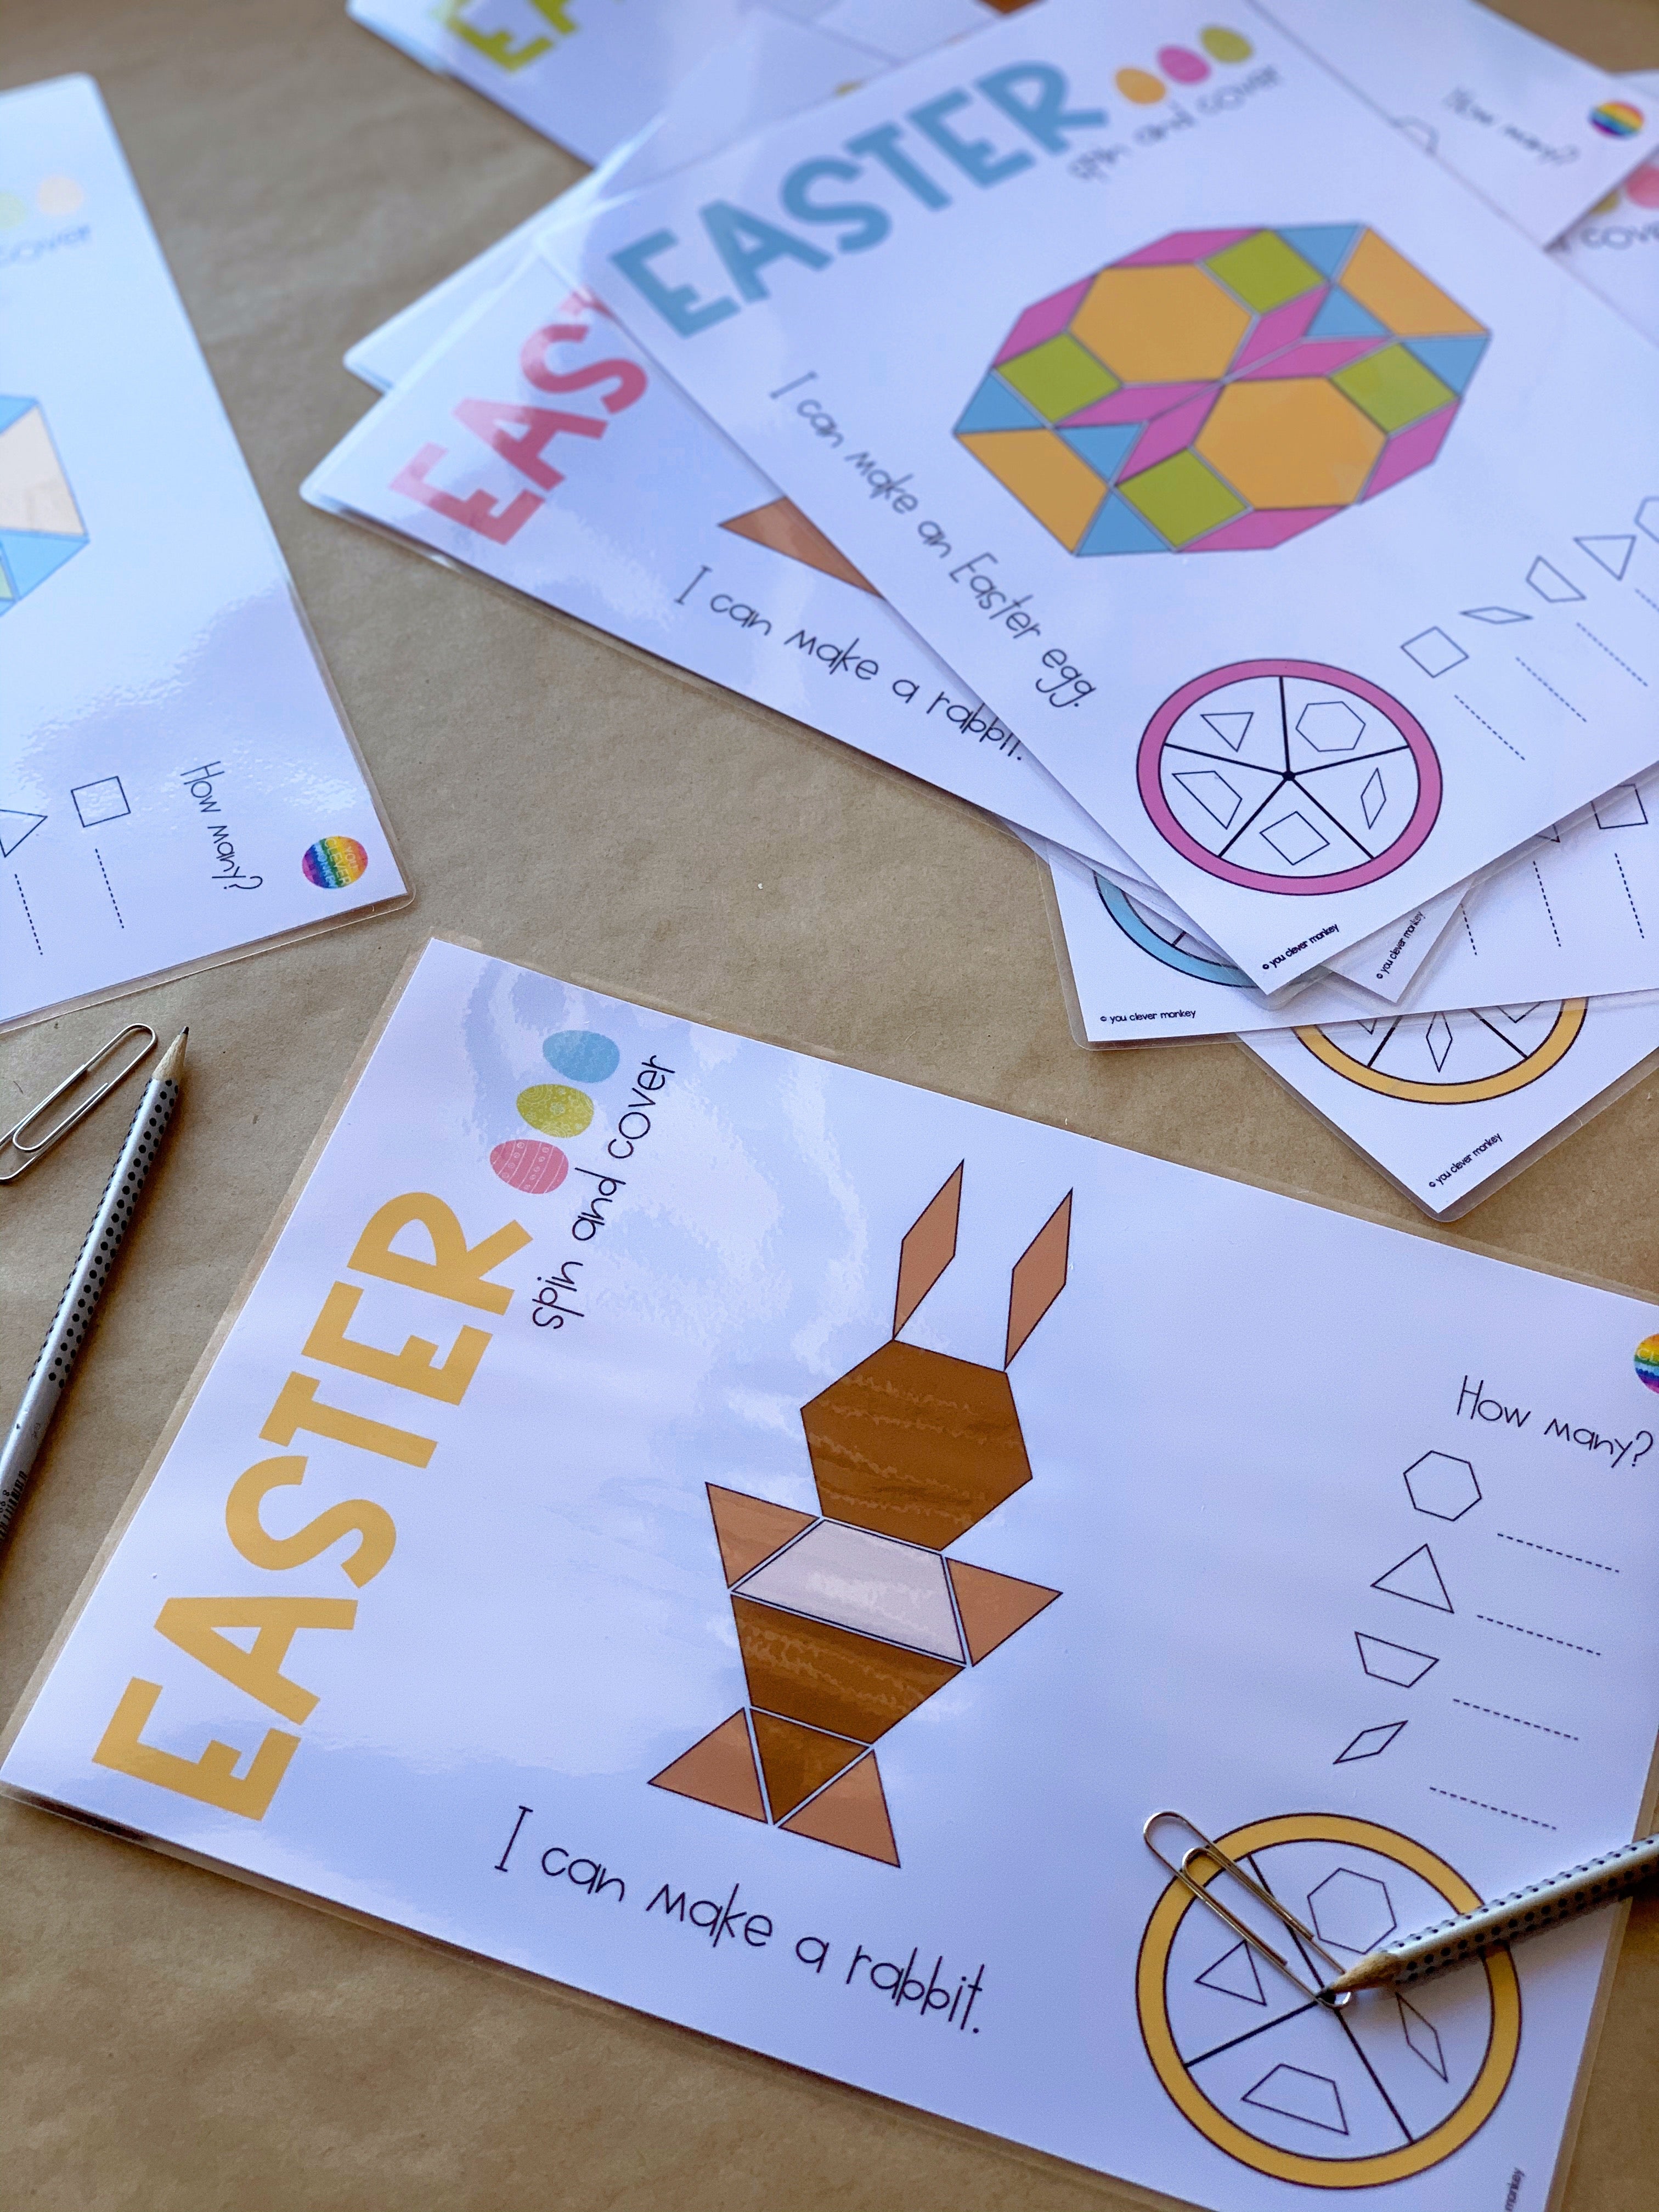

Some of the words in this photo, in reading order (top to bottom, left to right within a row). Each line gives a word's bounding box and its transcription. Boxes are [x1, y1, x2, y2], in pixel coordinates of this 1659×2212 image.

[608, 60, 1108, 338] EASTER
[770, 371, 817, 400] I
[797, 398, 844, 448] can
[845, 452, 918, 515] make
[918, 520, 952, 561] an
[949, 552, 1041, 640] Easter
[1036, 647, 1096, 707] egg.
[673, 565, 712, 606] I
[710, 594, 772, 636] can
[785, 629, 879, 680] make
[891, 678, 921, 704] a
[180, 761, 225, 812] How
[207, 825, 263, 889] many?
[325, 838, 352, 887] CLEVER
[1269, 955, 1286, 968] you
[1285, 940, 1308, 957] clever
[1308, 924, 1339, 944] monkey
[1380, 959, 1393, 974] you
[1390, 938, 1406, 960] clever
[1110, 1015, 1127, 1024] you
[1130, 1013, 1157, 1021] clever
[1160, 1009, 1196, 1018] monkey
[532, 1260, 584, 1329] spin
[572, 1167, 626, 1241] and
[608, 1055, 675, 1159] cover
[1436, 1171, 1452, 1186] you
[1451, 1154, 1472, 1172] clever
[1472, 1133, 1503, 1156] monkey
[1457, 1375, 1531, 1427] How
[1544, 1418, 1653, 1468] many?
[92, 1191, 533, 1821] EASTER
[494, 1805, 533, 1872] I
[541, 1847, 625, 1901] can
[646, 1883, 772, 1947] make
[795, 1936, 829, 1973] a
[846, 1945, 985, 2034] rabbit.
